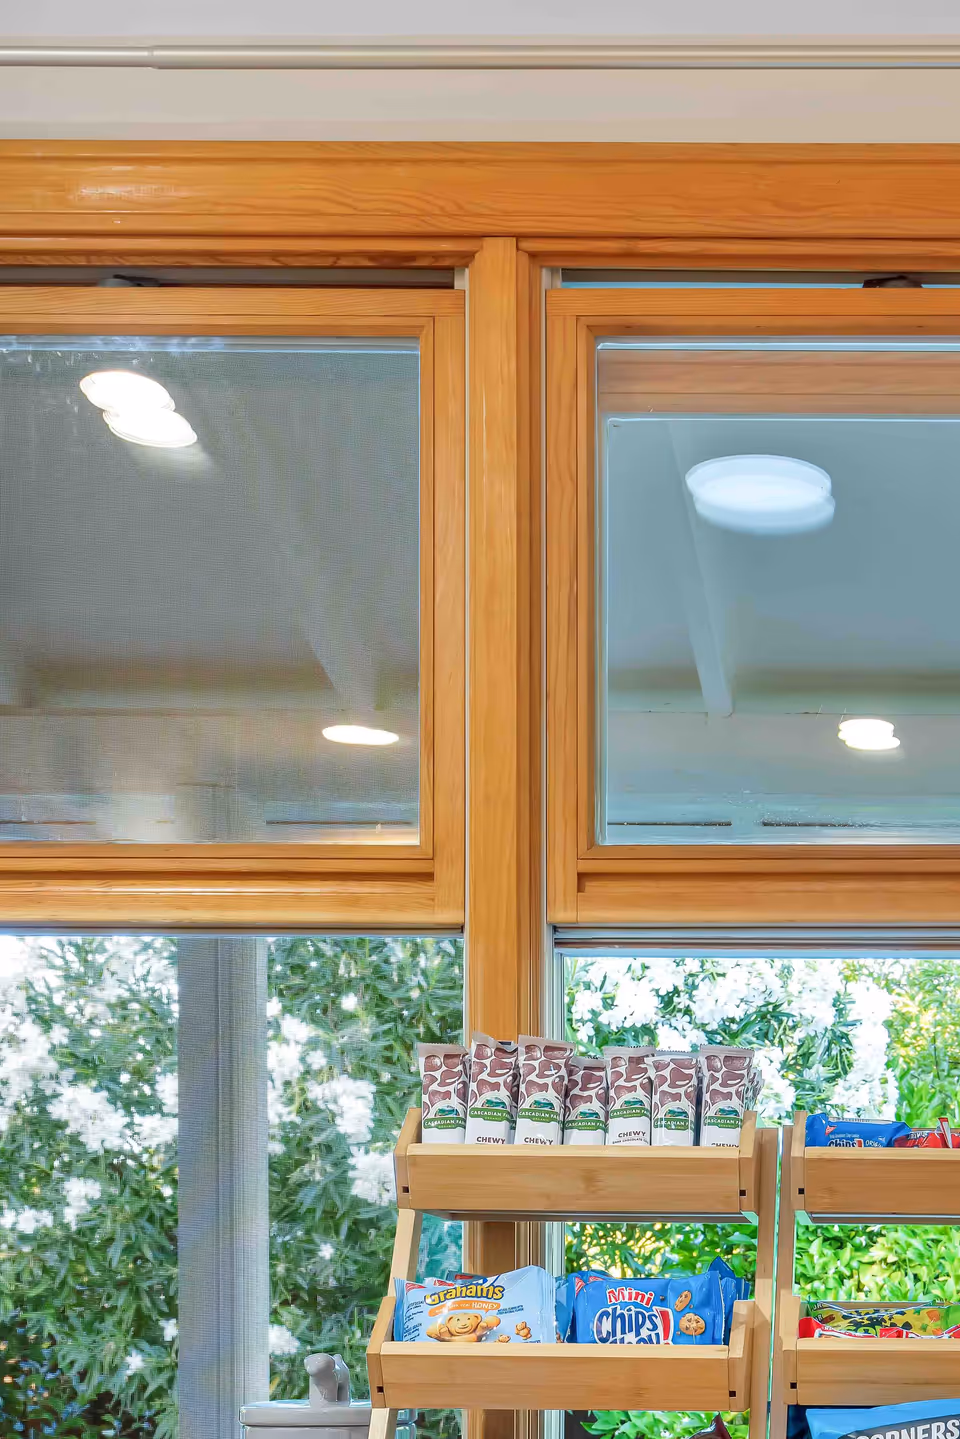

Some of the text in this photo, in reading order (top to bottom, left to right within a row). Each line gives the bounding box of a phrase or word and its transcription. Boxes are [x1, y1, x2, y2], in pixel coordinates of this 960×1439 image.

[471, 1109, 501, 1118] CASCADIAN
[519, 1110, 550, 1119] CASCADIAN
[610, 1108, 641, 1117] CASCADIAN
[565, 1120, 595, 1129] CASCADIAN
[654, 1120, 685, 1128] CASCADIAN
[617, 1130, 647, 1138] CHEWY
[476, 1136, 506, 1145] CHEWY
[523, 1136, 554, 1146] CHEWY
[424, 1283, 505, 1306] Grahams
[606, 1286, 655, 1308] Mini
[471, 1301, 499, 1311] HONEY
[595, 1306, 660, 1344] Chips
